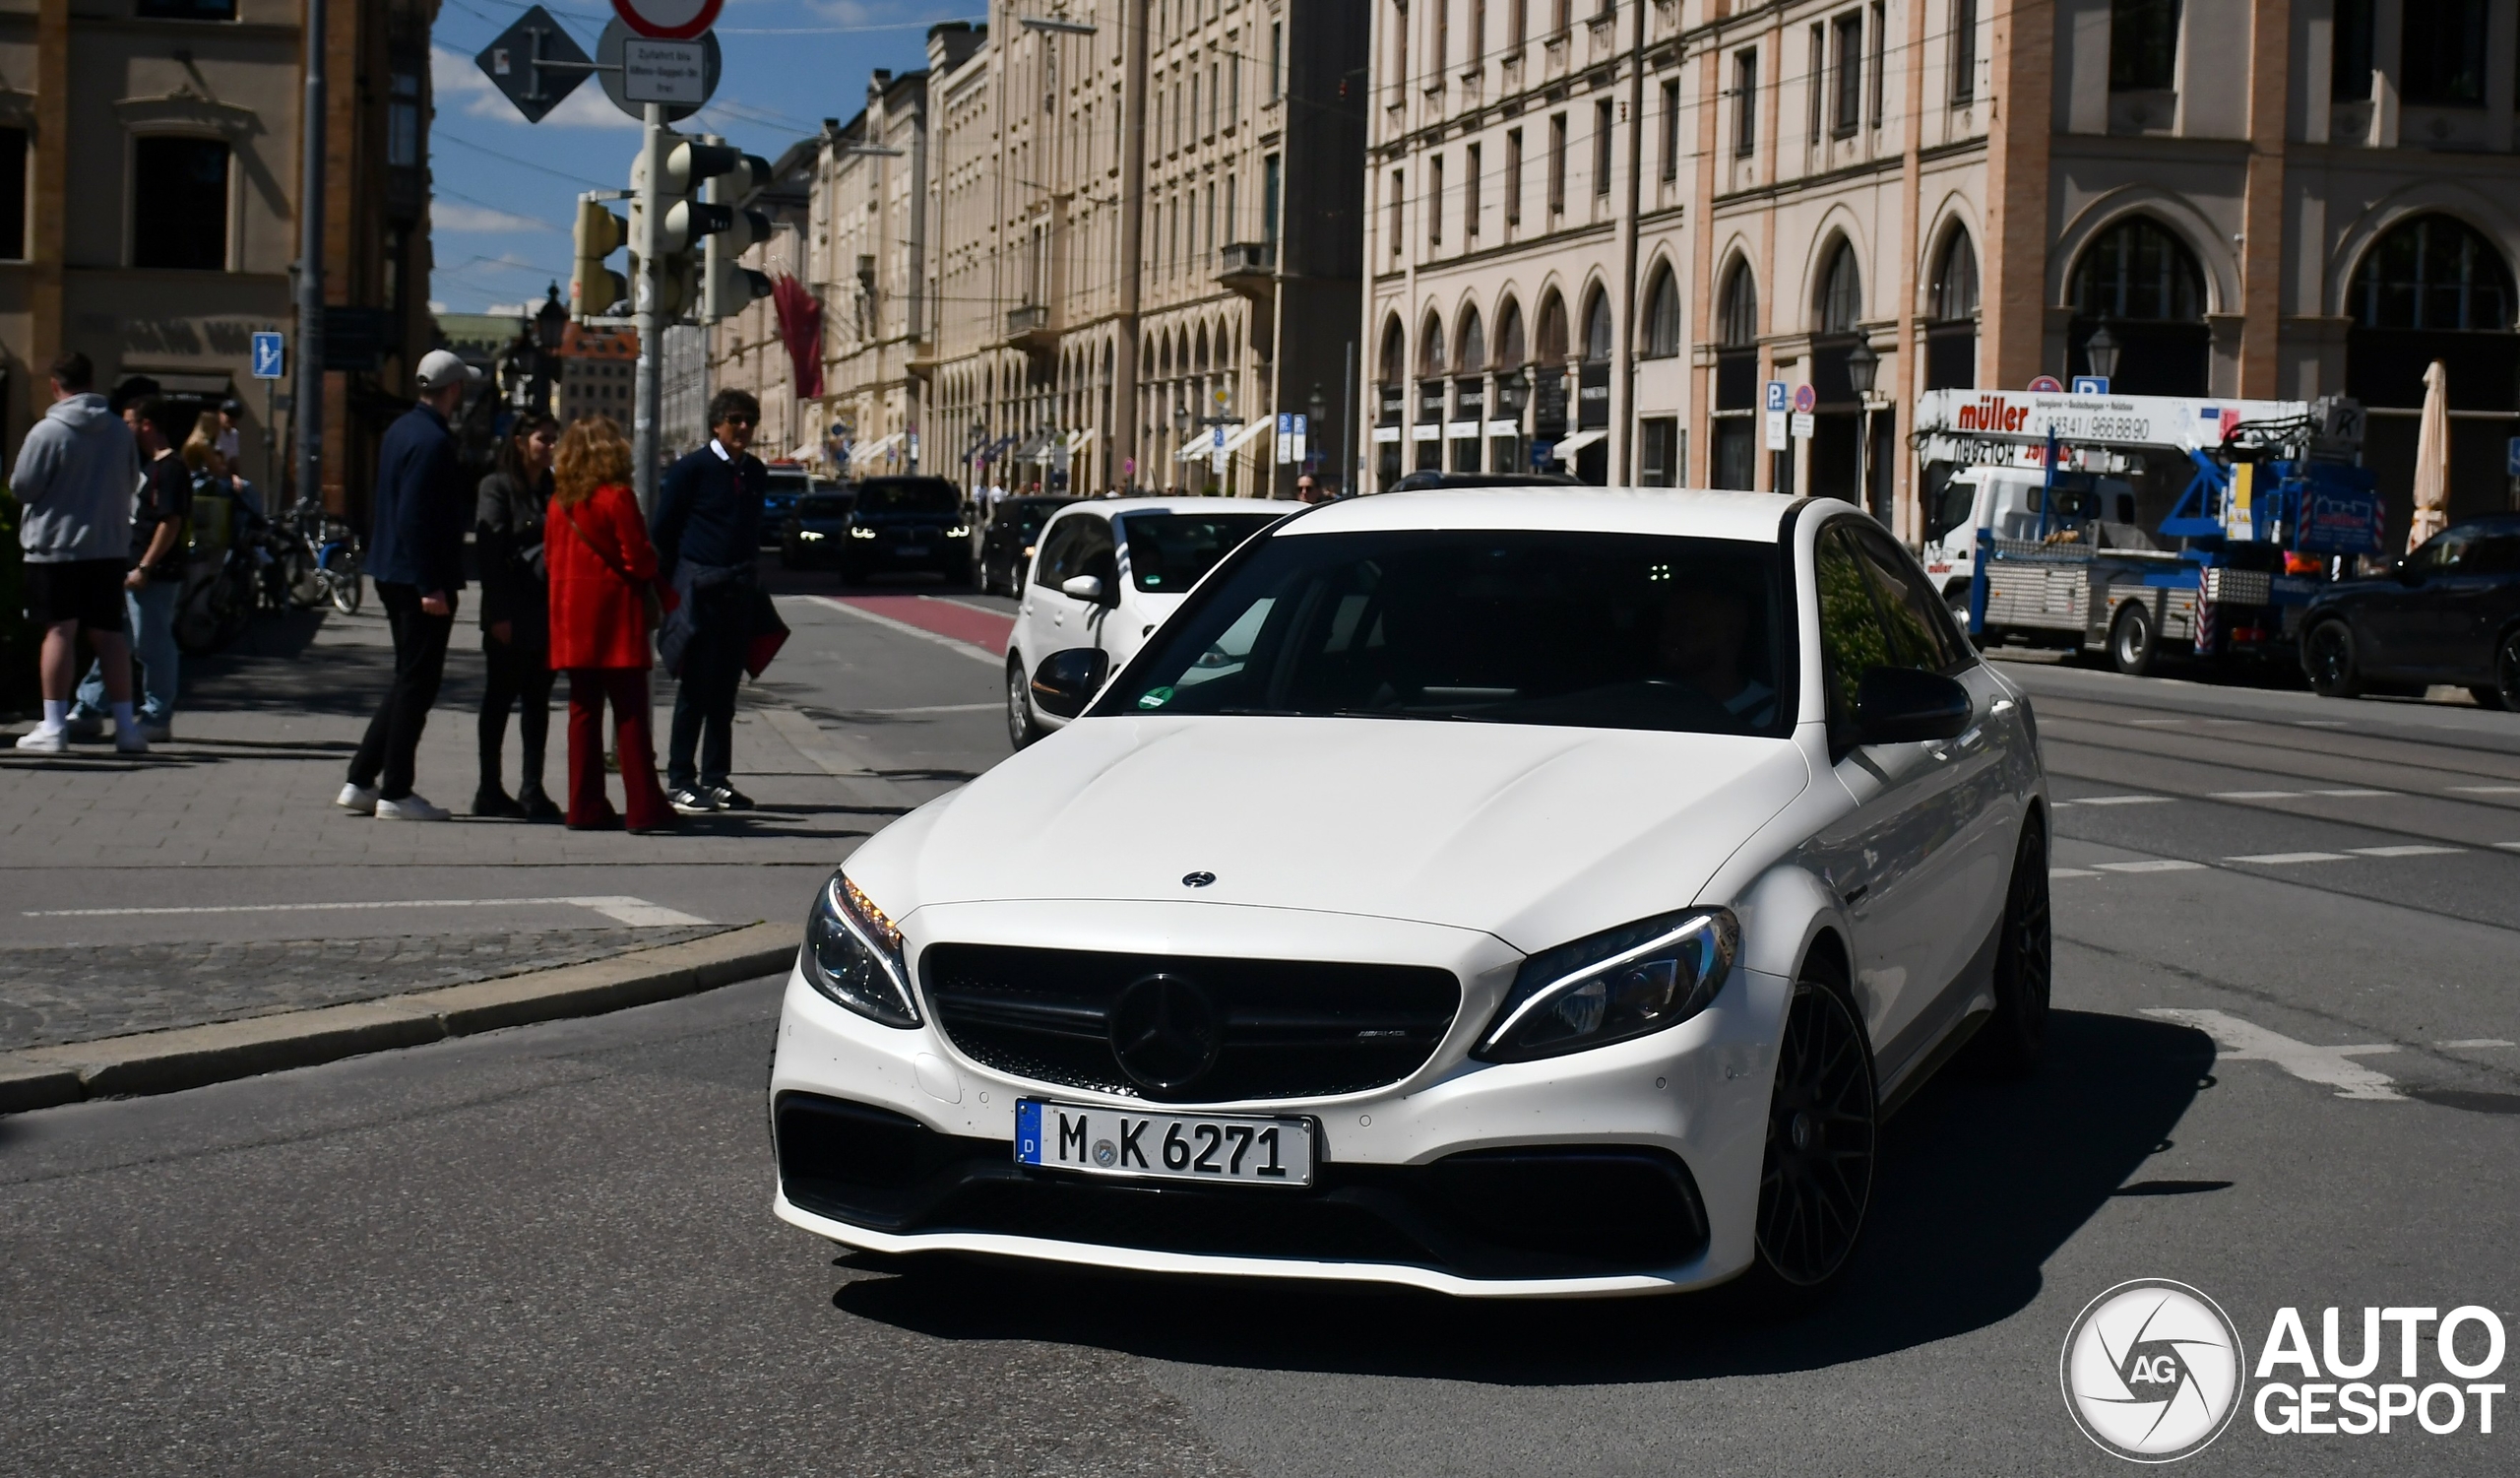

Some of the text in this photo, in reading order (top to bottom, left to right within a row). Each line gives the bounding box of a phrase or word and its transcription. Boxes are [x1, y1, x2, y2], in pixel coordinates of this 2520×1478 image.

[1958, 395, 2029, 432] müller
[1024, 1139, 1035, 1153] D
[1059, 1112, 1287, 1177] M K 6271
